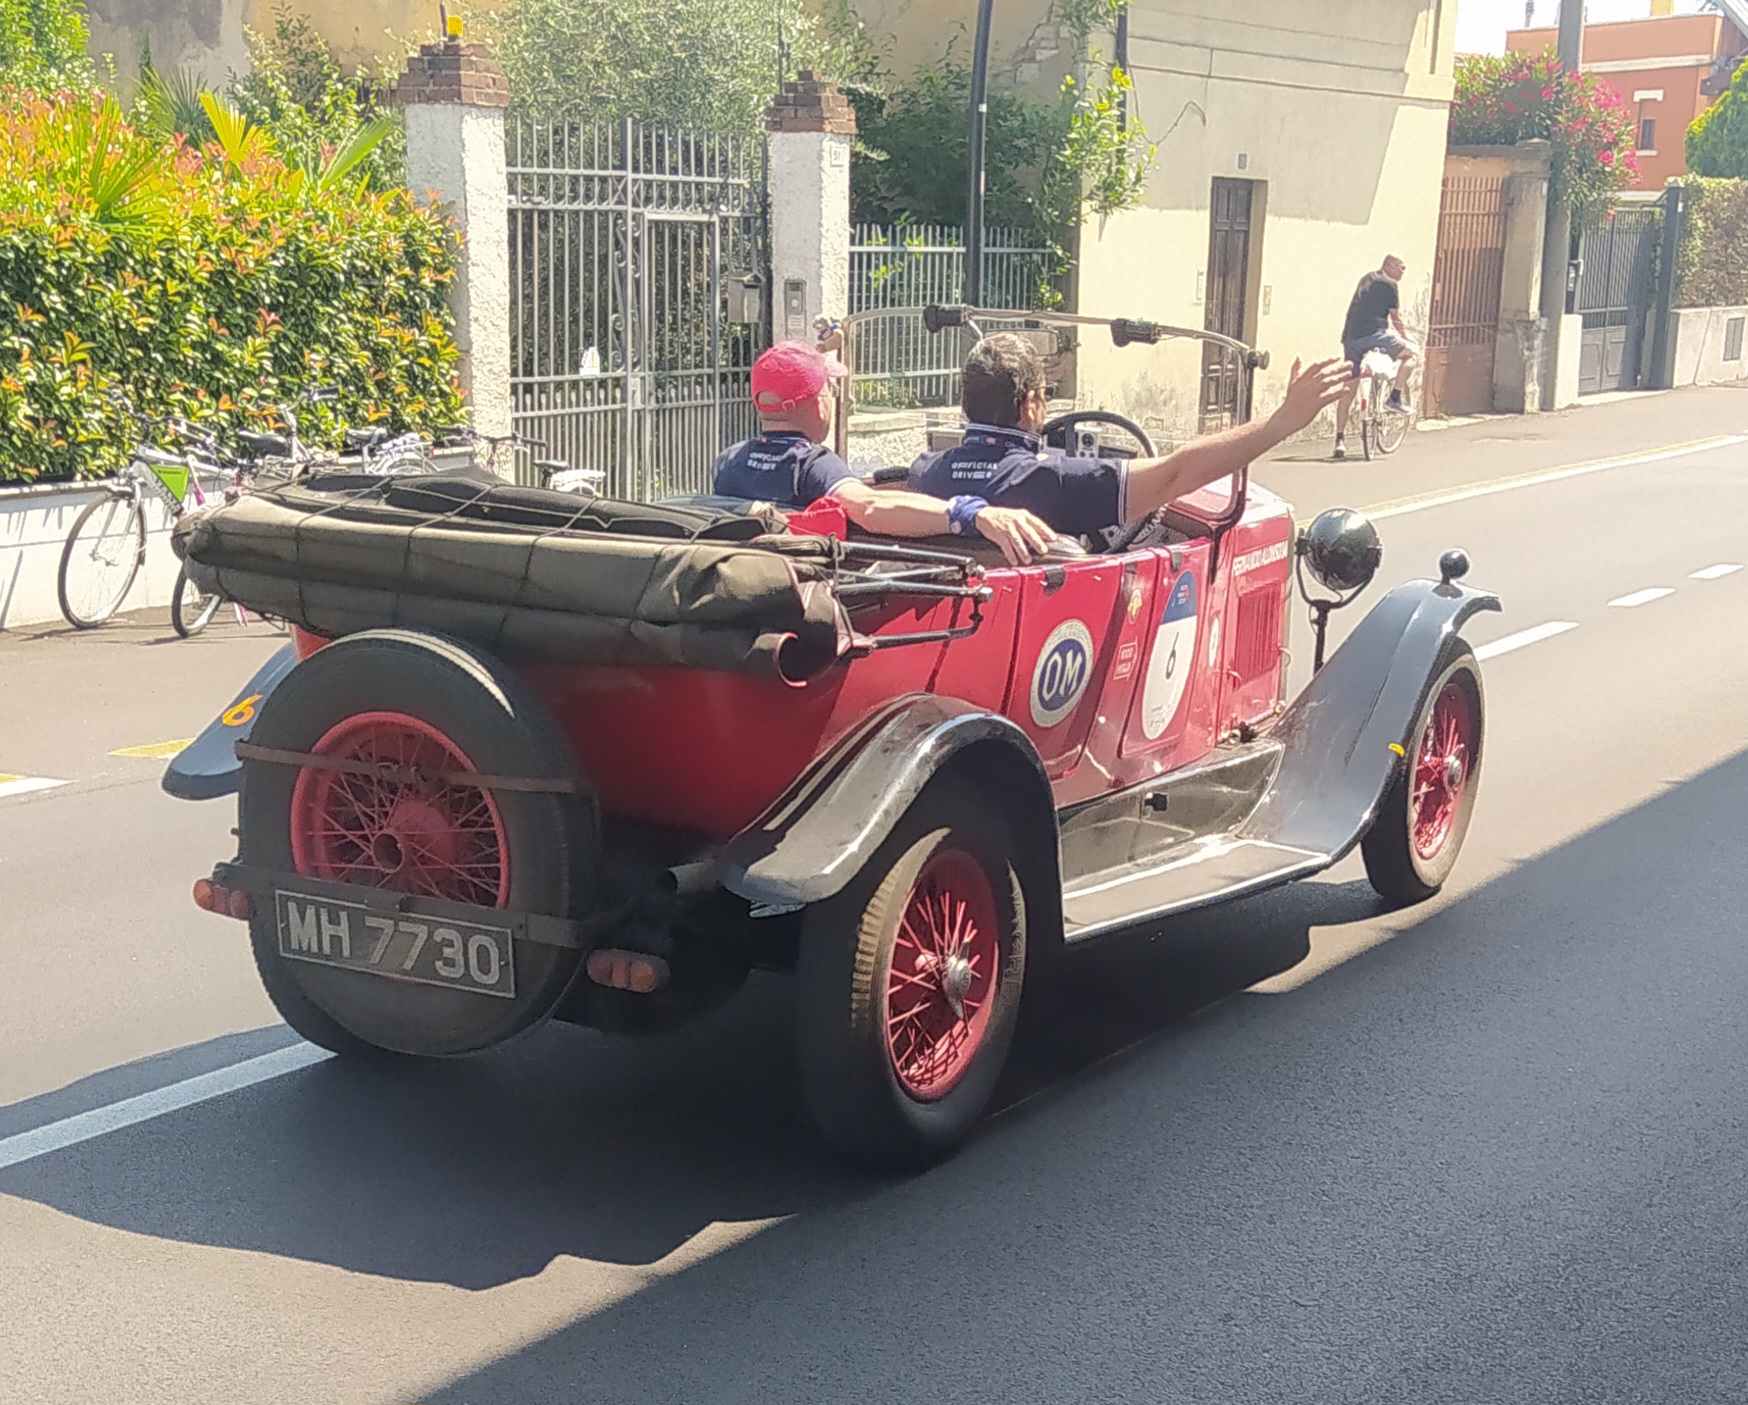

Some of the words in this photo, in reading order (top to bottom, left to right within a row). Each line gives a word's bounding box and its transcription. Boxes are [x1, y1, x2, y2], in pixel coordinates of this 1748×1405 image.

[951, 461, 998, 470] OFFICIAL
[951, 471, 993, 479] DRIVER
[1042, 648, 1083, 702] OM
[1165, 631, 1180, 681] 6
[222, 694, 264, 727] 6
[287, 901, 351, 959] MH
[364, 915, 501, 986] 7730
